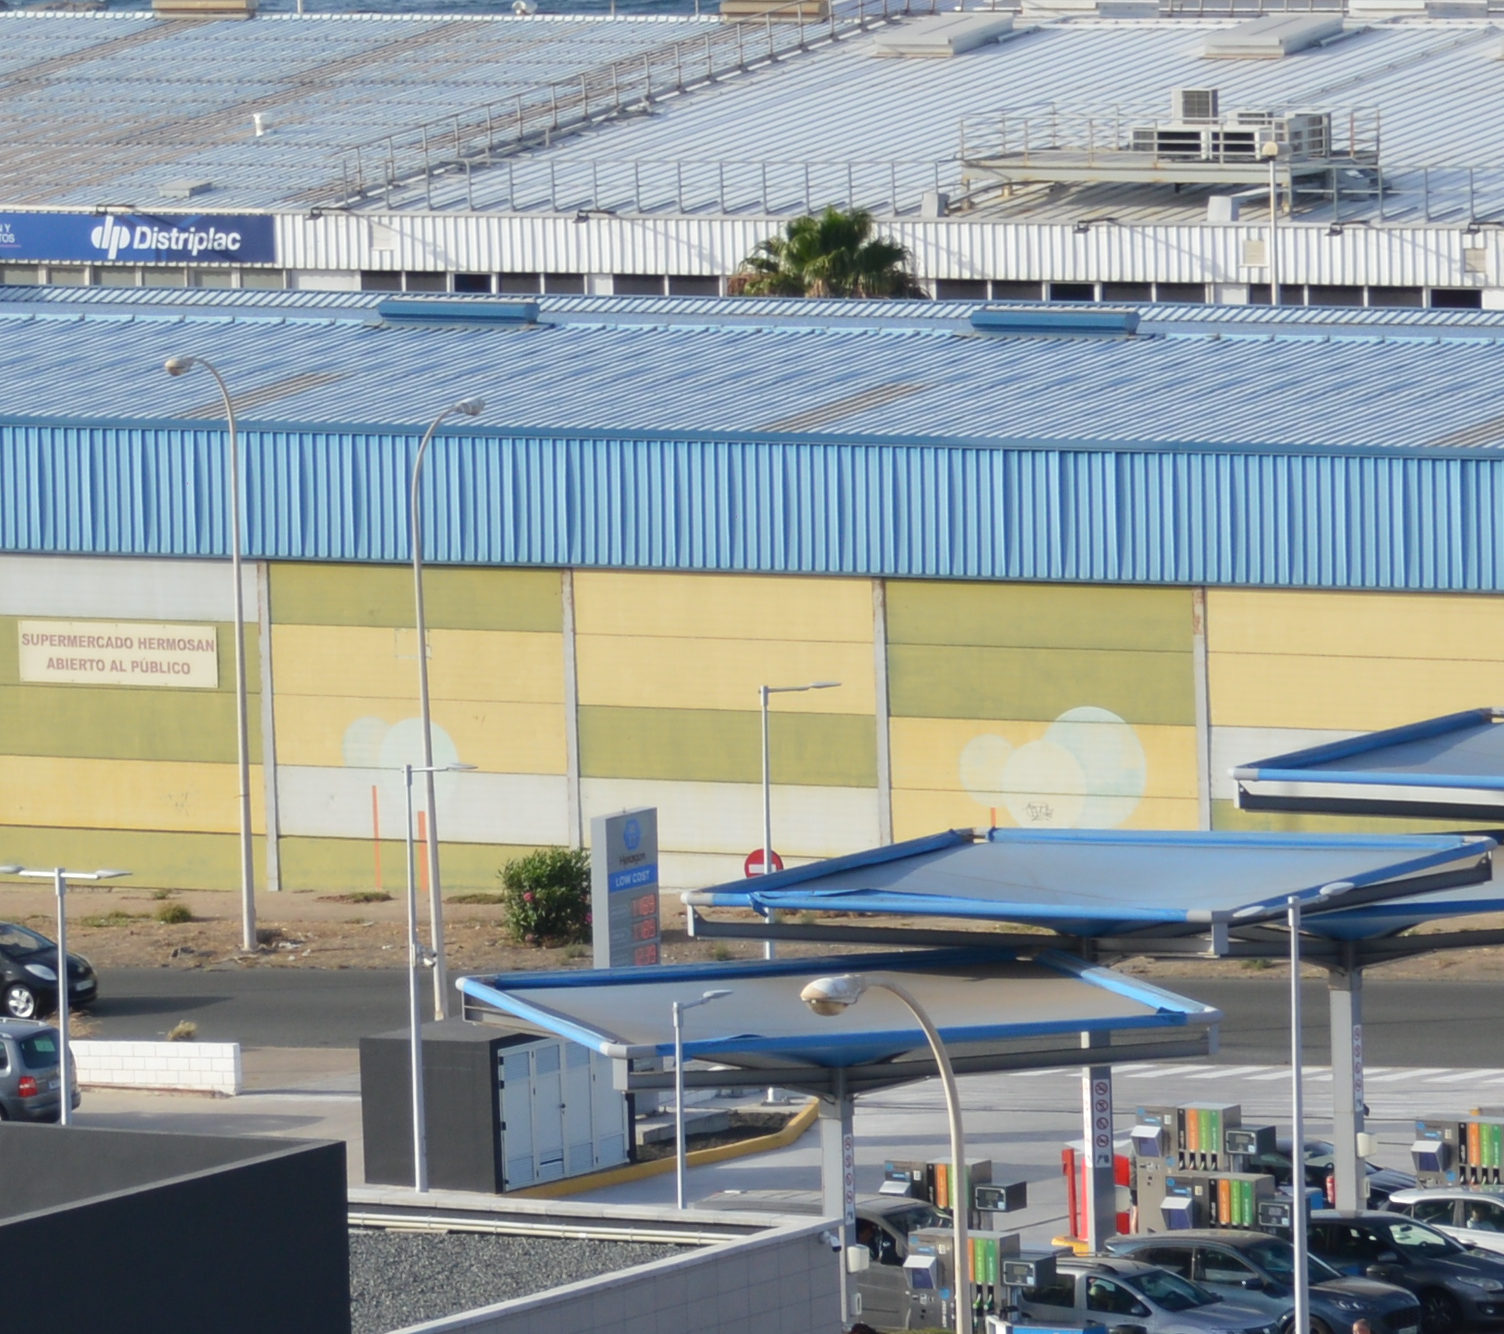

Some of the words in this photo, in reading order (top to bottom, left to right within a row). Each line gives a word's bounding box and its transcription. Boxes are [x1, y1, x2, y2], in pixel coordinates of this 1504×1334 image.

[3, 223, 12, 233] Y
[133, 226, 242, 257] Distriplac
[21, 632, 134, 650] SUPERMERCADO
[137, 637, 215, 653] HERMOSAN
[46, 657, 106, 672] ABIERTO
[109, 659, 127, 673] AL
[131, 657, 191, 675] PÚBLICO
[615, 873, 632, 887] LOW
[632, 869, 651, 884] COST
